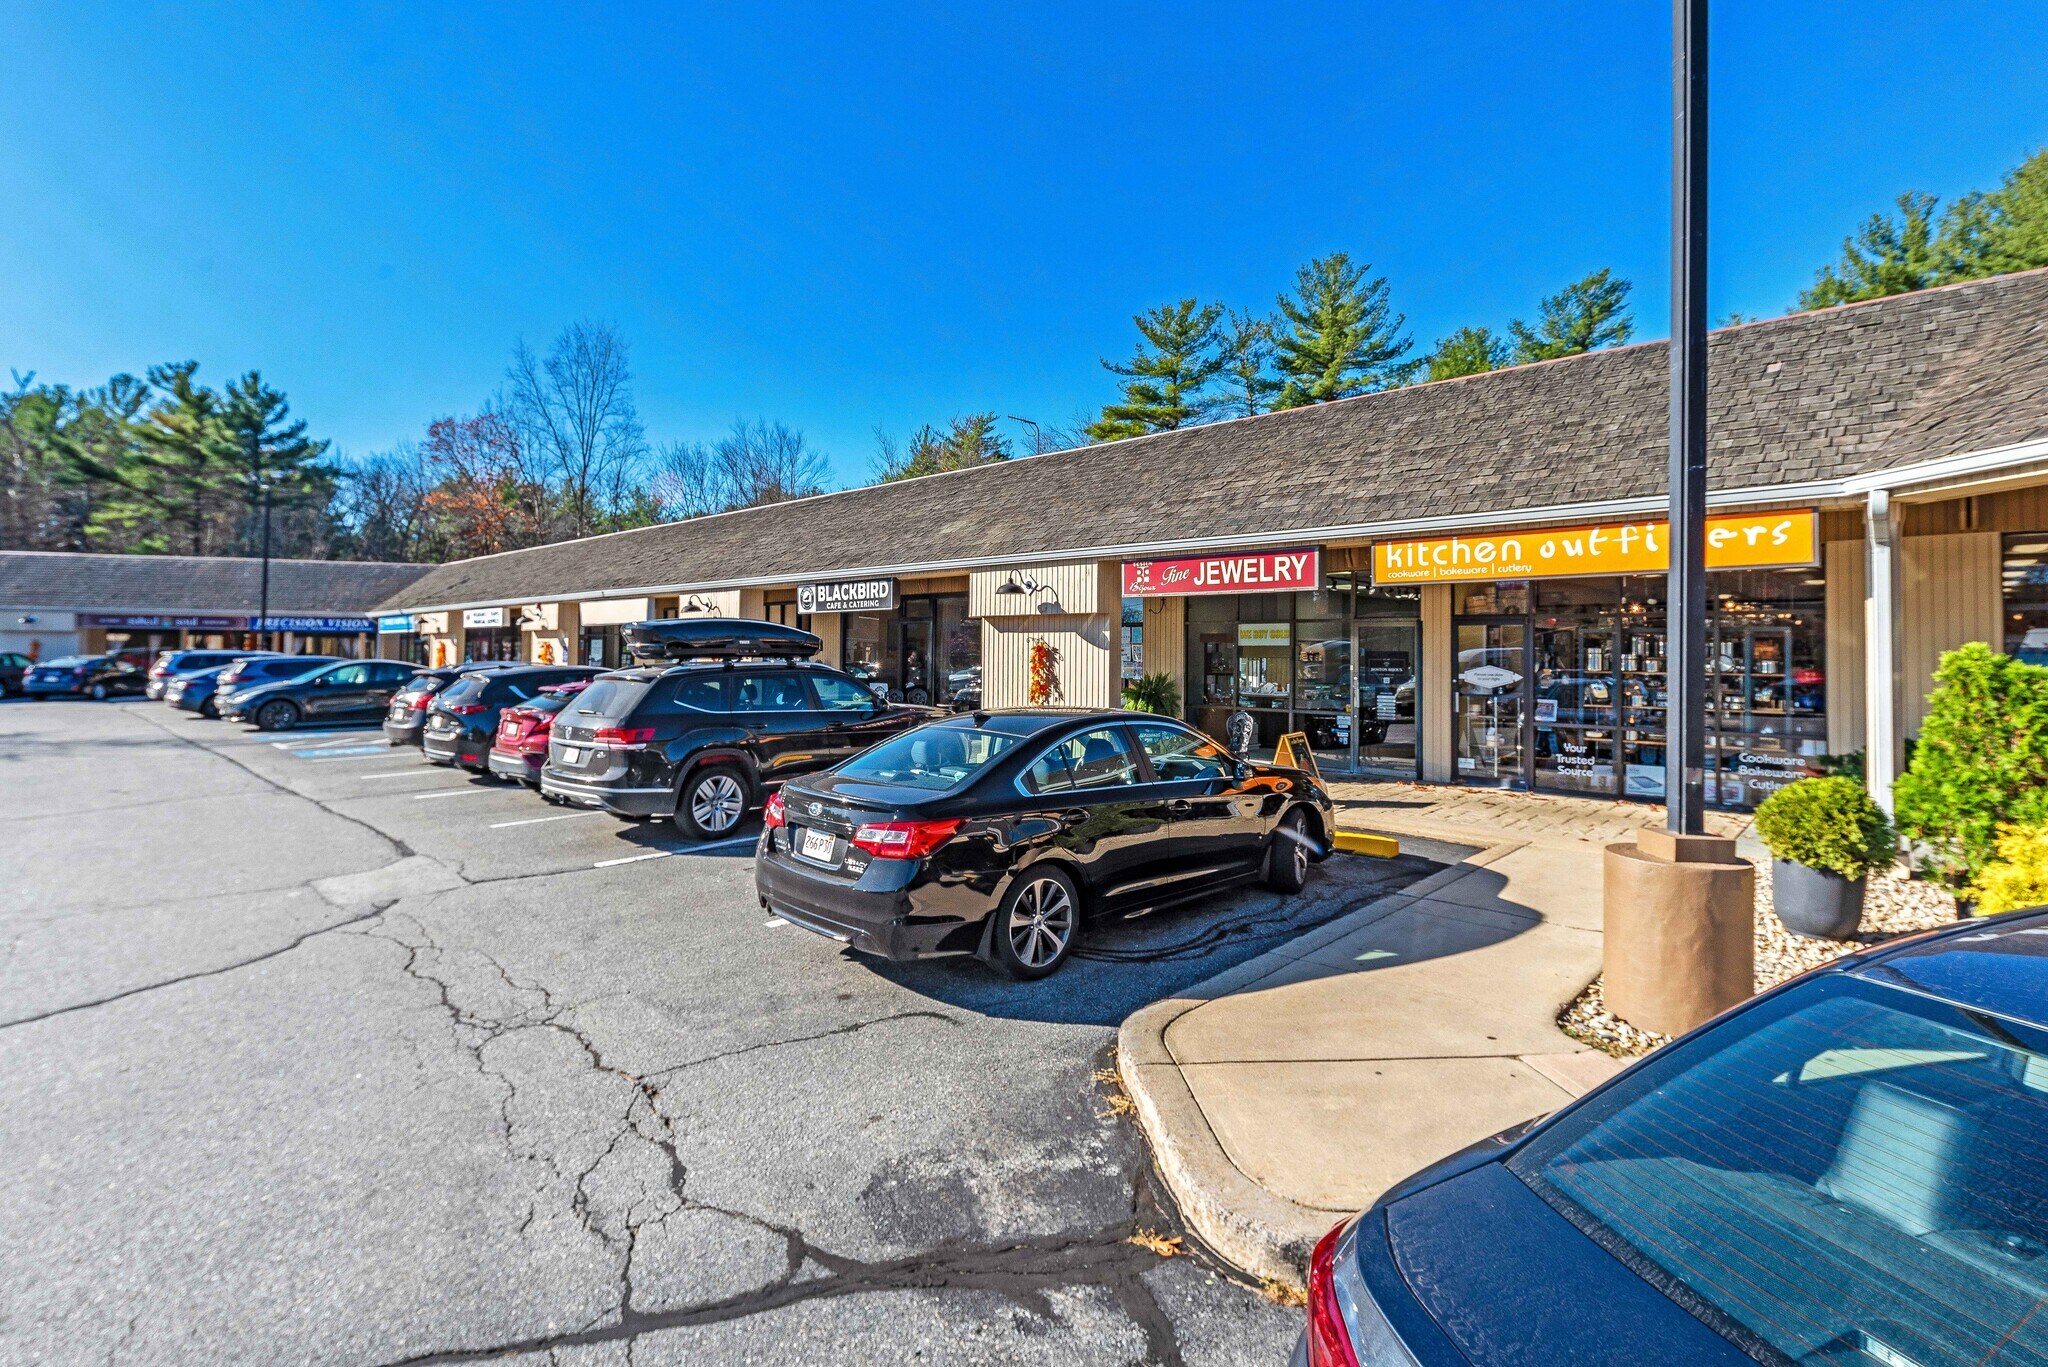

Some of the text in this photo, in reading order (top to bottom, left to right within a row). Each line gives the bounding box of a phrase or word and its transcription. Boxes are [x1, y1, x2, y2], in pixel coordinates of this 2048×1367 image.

[1387, 521, 1792, 568] kitchen outfiers
[1160, 554, 1308, 586] Fine JEWELRY
[1387, 562, 1532, 579] cookware bakeware cutlery
[817, 581, 889, 602] BLACKBIRD
[826, 602, 841, 610] CAFE
[848, 599, 880, 609] CATERING
[328, 618, 371, 628] VISION
[1563, 742, 1588, 754] Your
[1556, 754, 1596, 766] Trusted
[1738, 752, 1806, 767] Cookware
[1557, 765, 1594, 778] Source
[1738, 764, 1806, 780] Bakeware
[1749, 778, 1788, 790] Cutle
